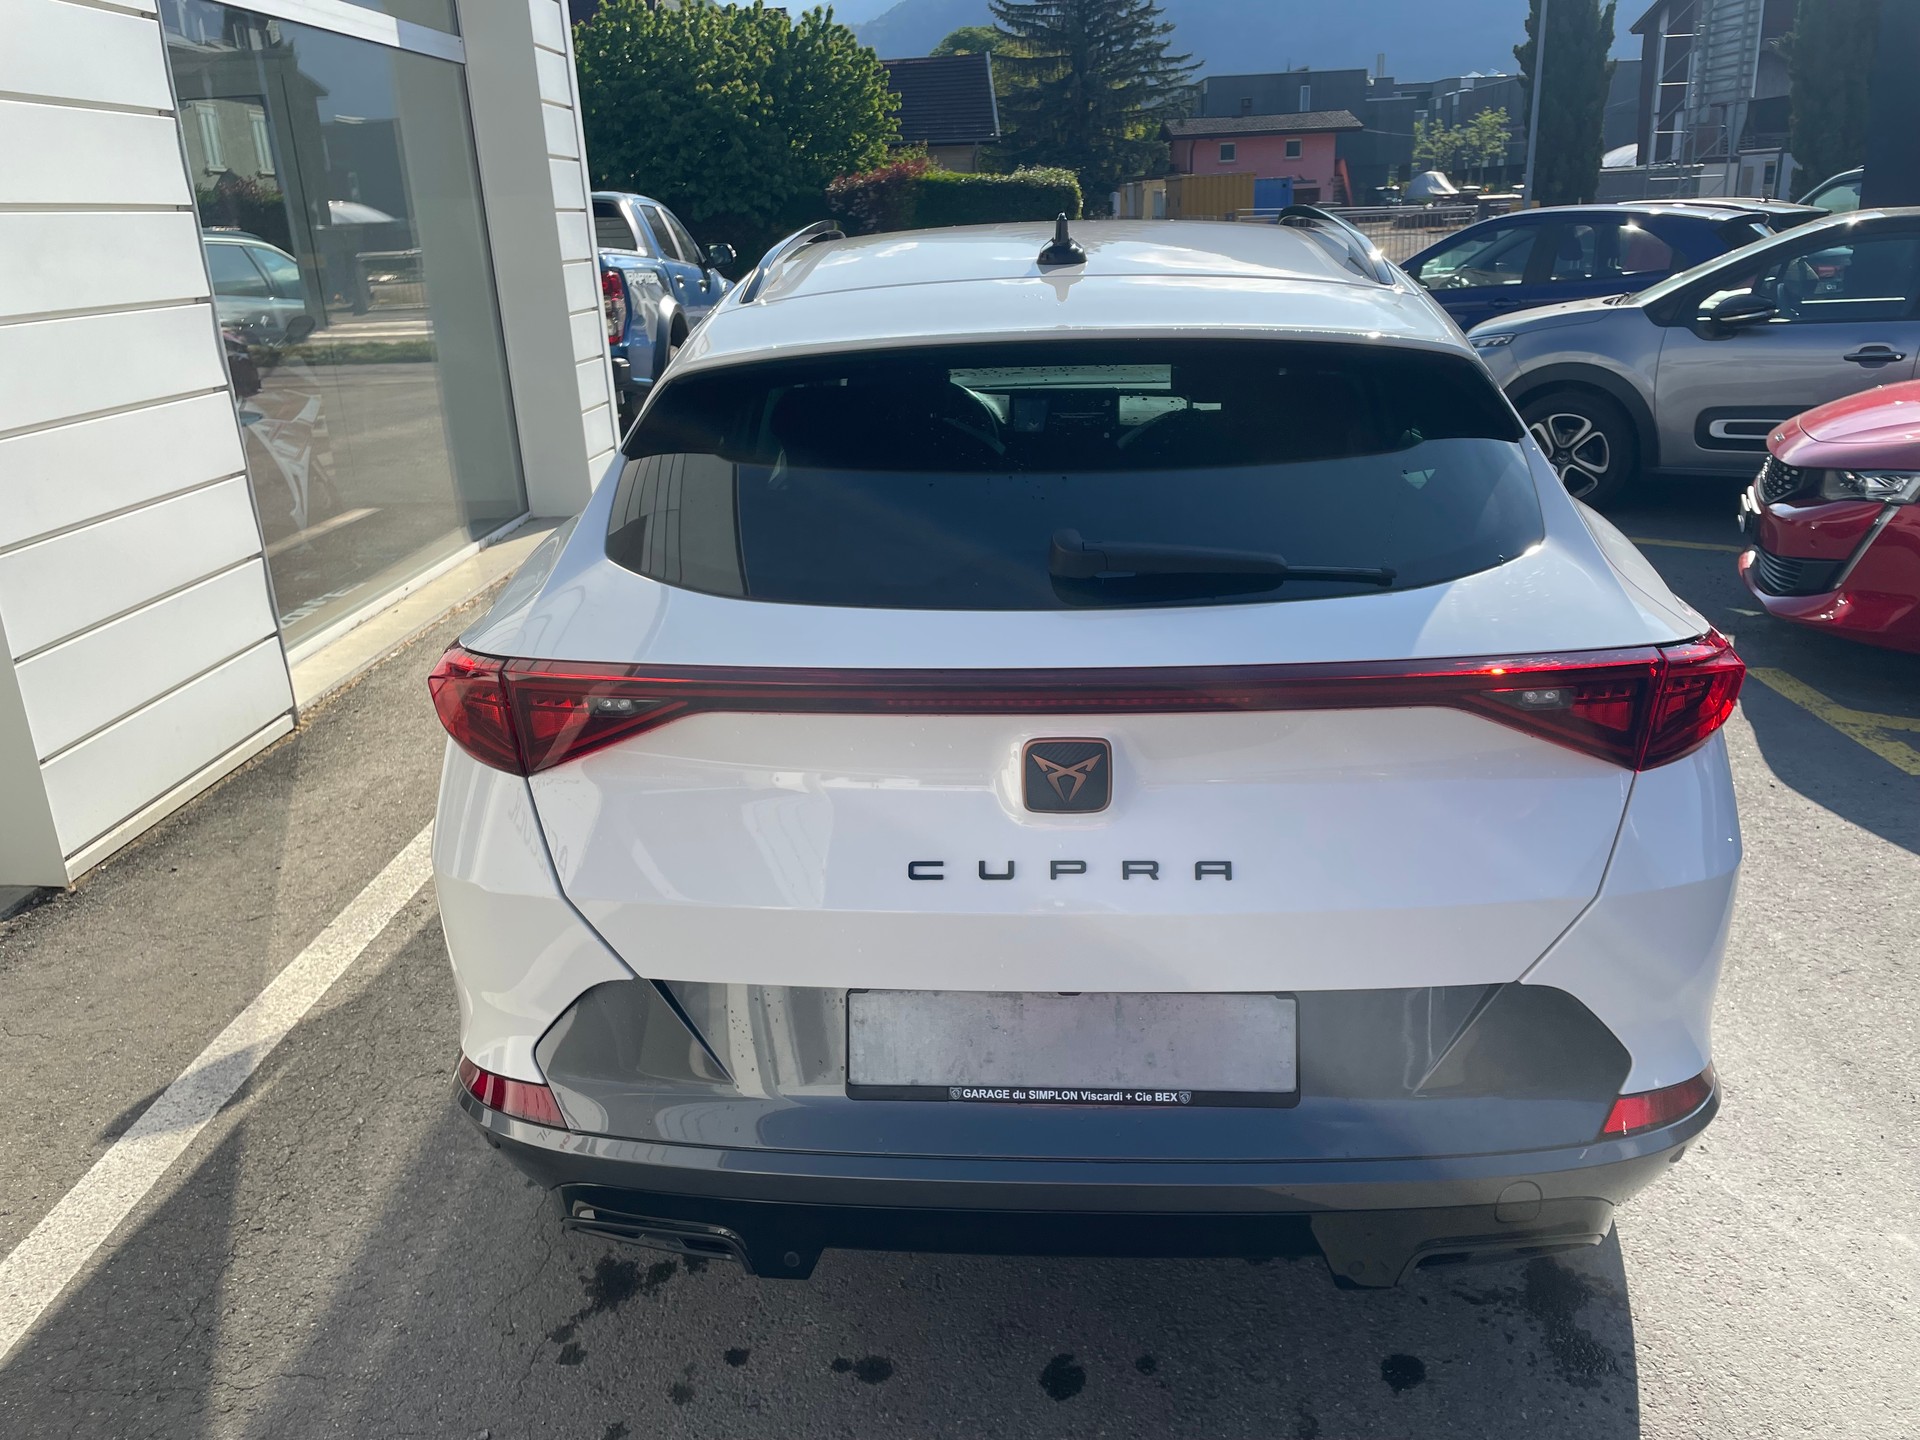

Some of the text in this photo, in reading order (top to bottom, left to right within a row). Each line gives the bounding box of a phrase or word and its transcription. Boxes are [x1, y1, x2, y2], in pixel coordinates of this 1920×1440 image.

[626, 271, 659, 285] RAPTOR
[908, 860, 1232, 881] CUPRA
[962, 1088, 1010, 1099] GARAGE
[1012, 1089, 1026, 1100] du
[1028, 1090, 1078, 1101] SIMPLON
[1080, 1091, 1123, 1101] Viscardi
[1135, 1091, 1153, 1102] Cie
[1155, 1092, 1178, 1102] BEX
